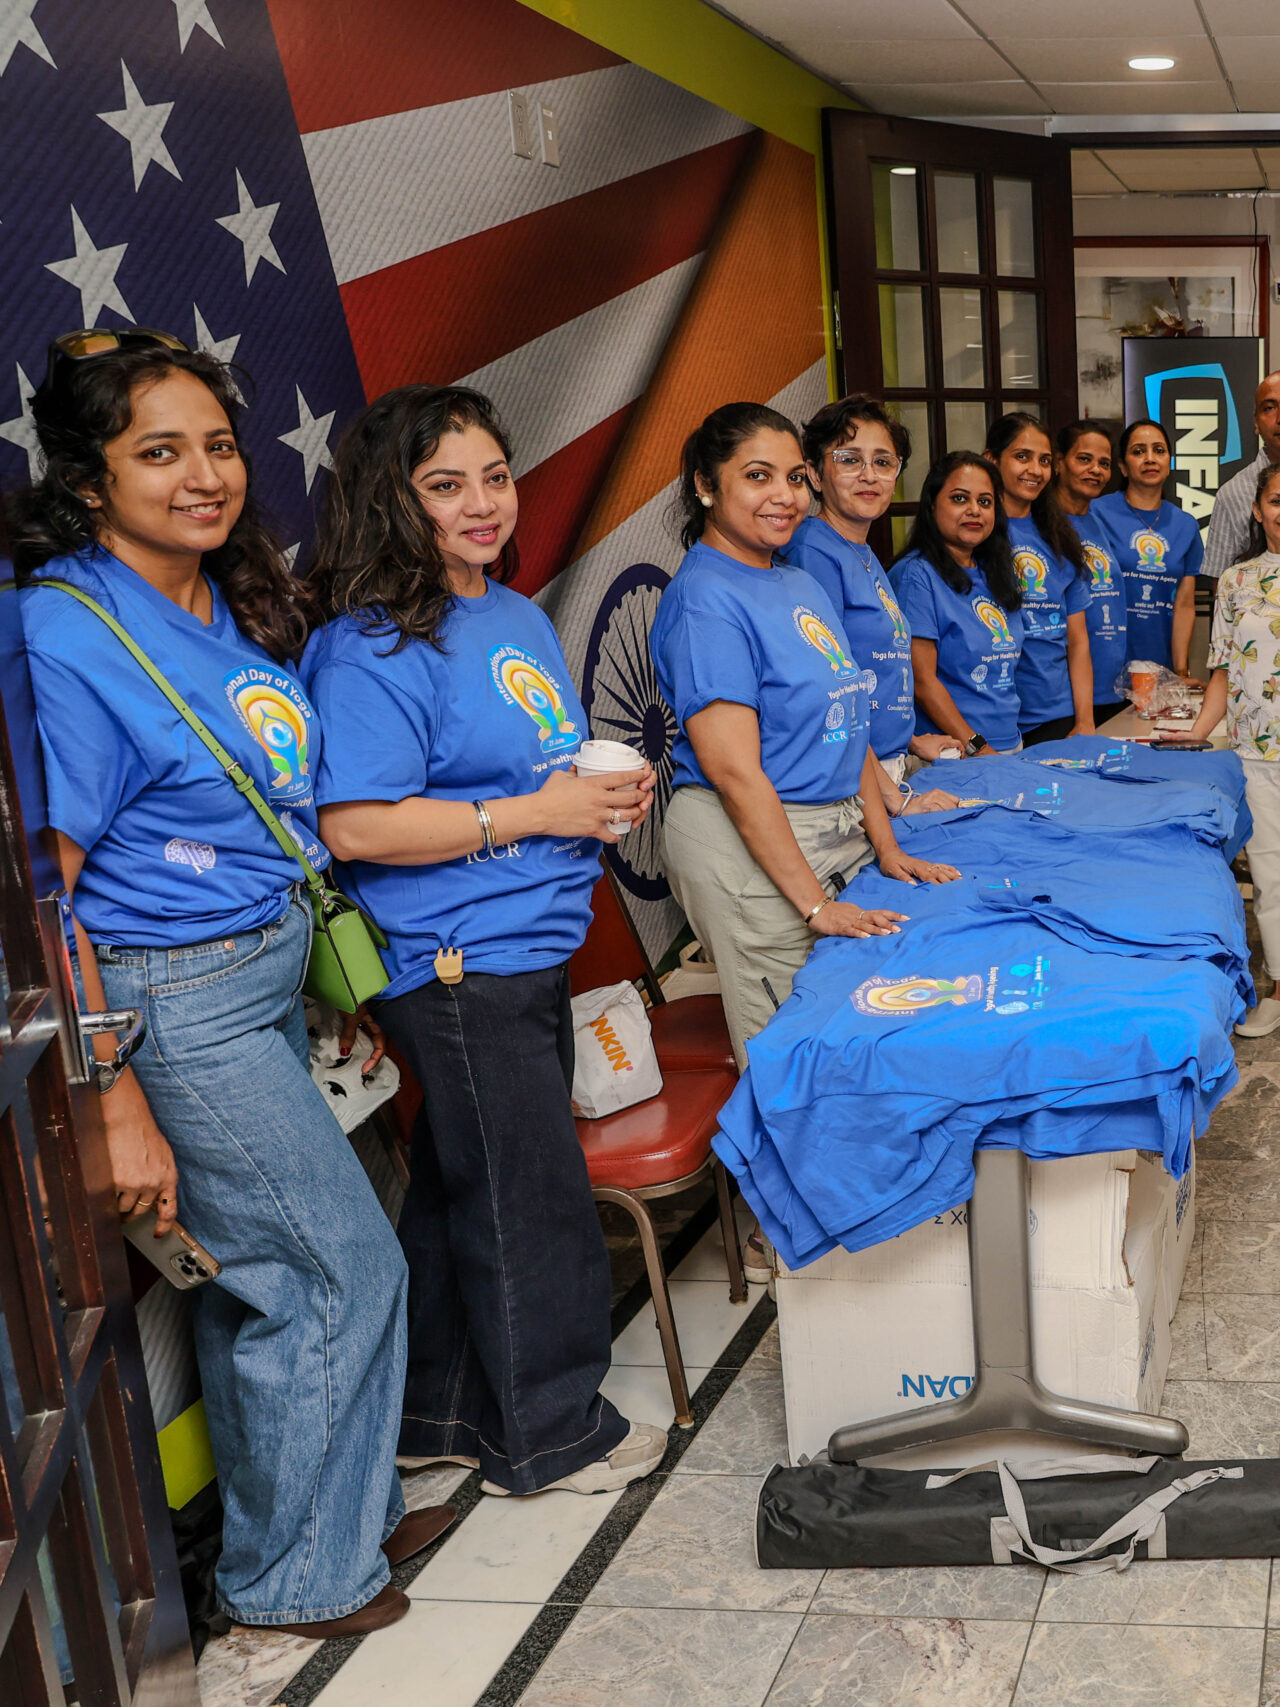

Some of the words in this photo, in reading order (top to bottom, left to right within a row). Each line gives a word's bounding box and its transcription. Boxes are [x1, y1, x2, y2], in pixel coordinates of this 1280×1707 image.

[1175, 399, 1219, 546] INFA
[1022, 602, 1041, 610] ealthy
[490, 647, 514, 705] International
[506, 646, 525, 660] Day
[526, 656, 538, 666] of
[538, 664, 560, 689] Yoga
[248, 668, 273, 684] Day
[274, 676, 289, 690] of
[289, 685, 312, 719] Yoga
[823, 731, 848, 743] ICCR
[532, 762, 548, 772] oga
[550, 754, 578, 768] ealthy
[466, 842, 522, 865] ICCR
[902, 1375, 974, 1398] DAN
